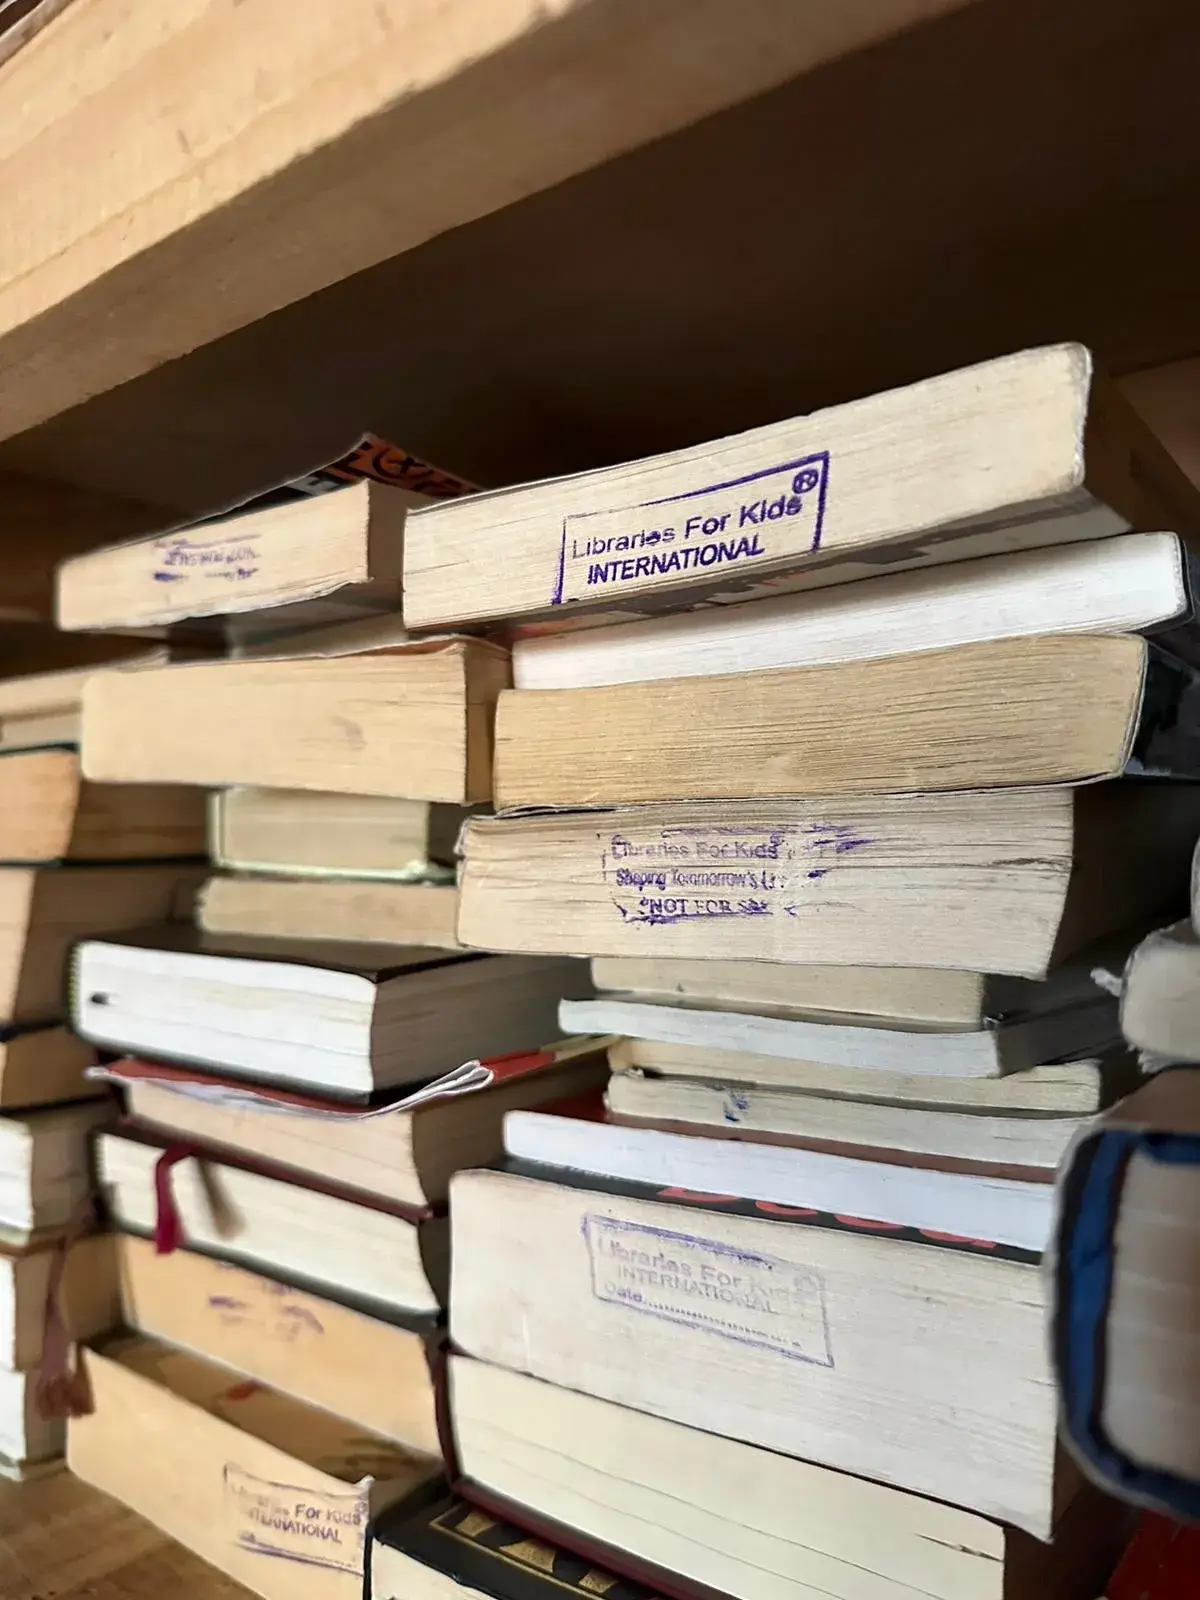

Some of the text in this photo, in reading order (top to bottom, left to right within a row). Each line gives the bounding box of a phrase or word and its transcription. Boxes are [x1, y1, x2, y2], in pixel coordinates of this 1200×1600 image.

[572, 526, 676, 560] Libraries
[684, 514, 732, 540] For
[586, 533, 766, 585] INTERNATIONAL
[617, 1265, 781, 1316] INTERNATIONAL
[700, 1263, 743, 1289] For
[295, 1503, 322, 1520] For
